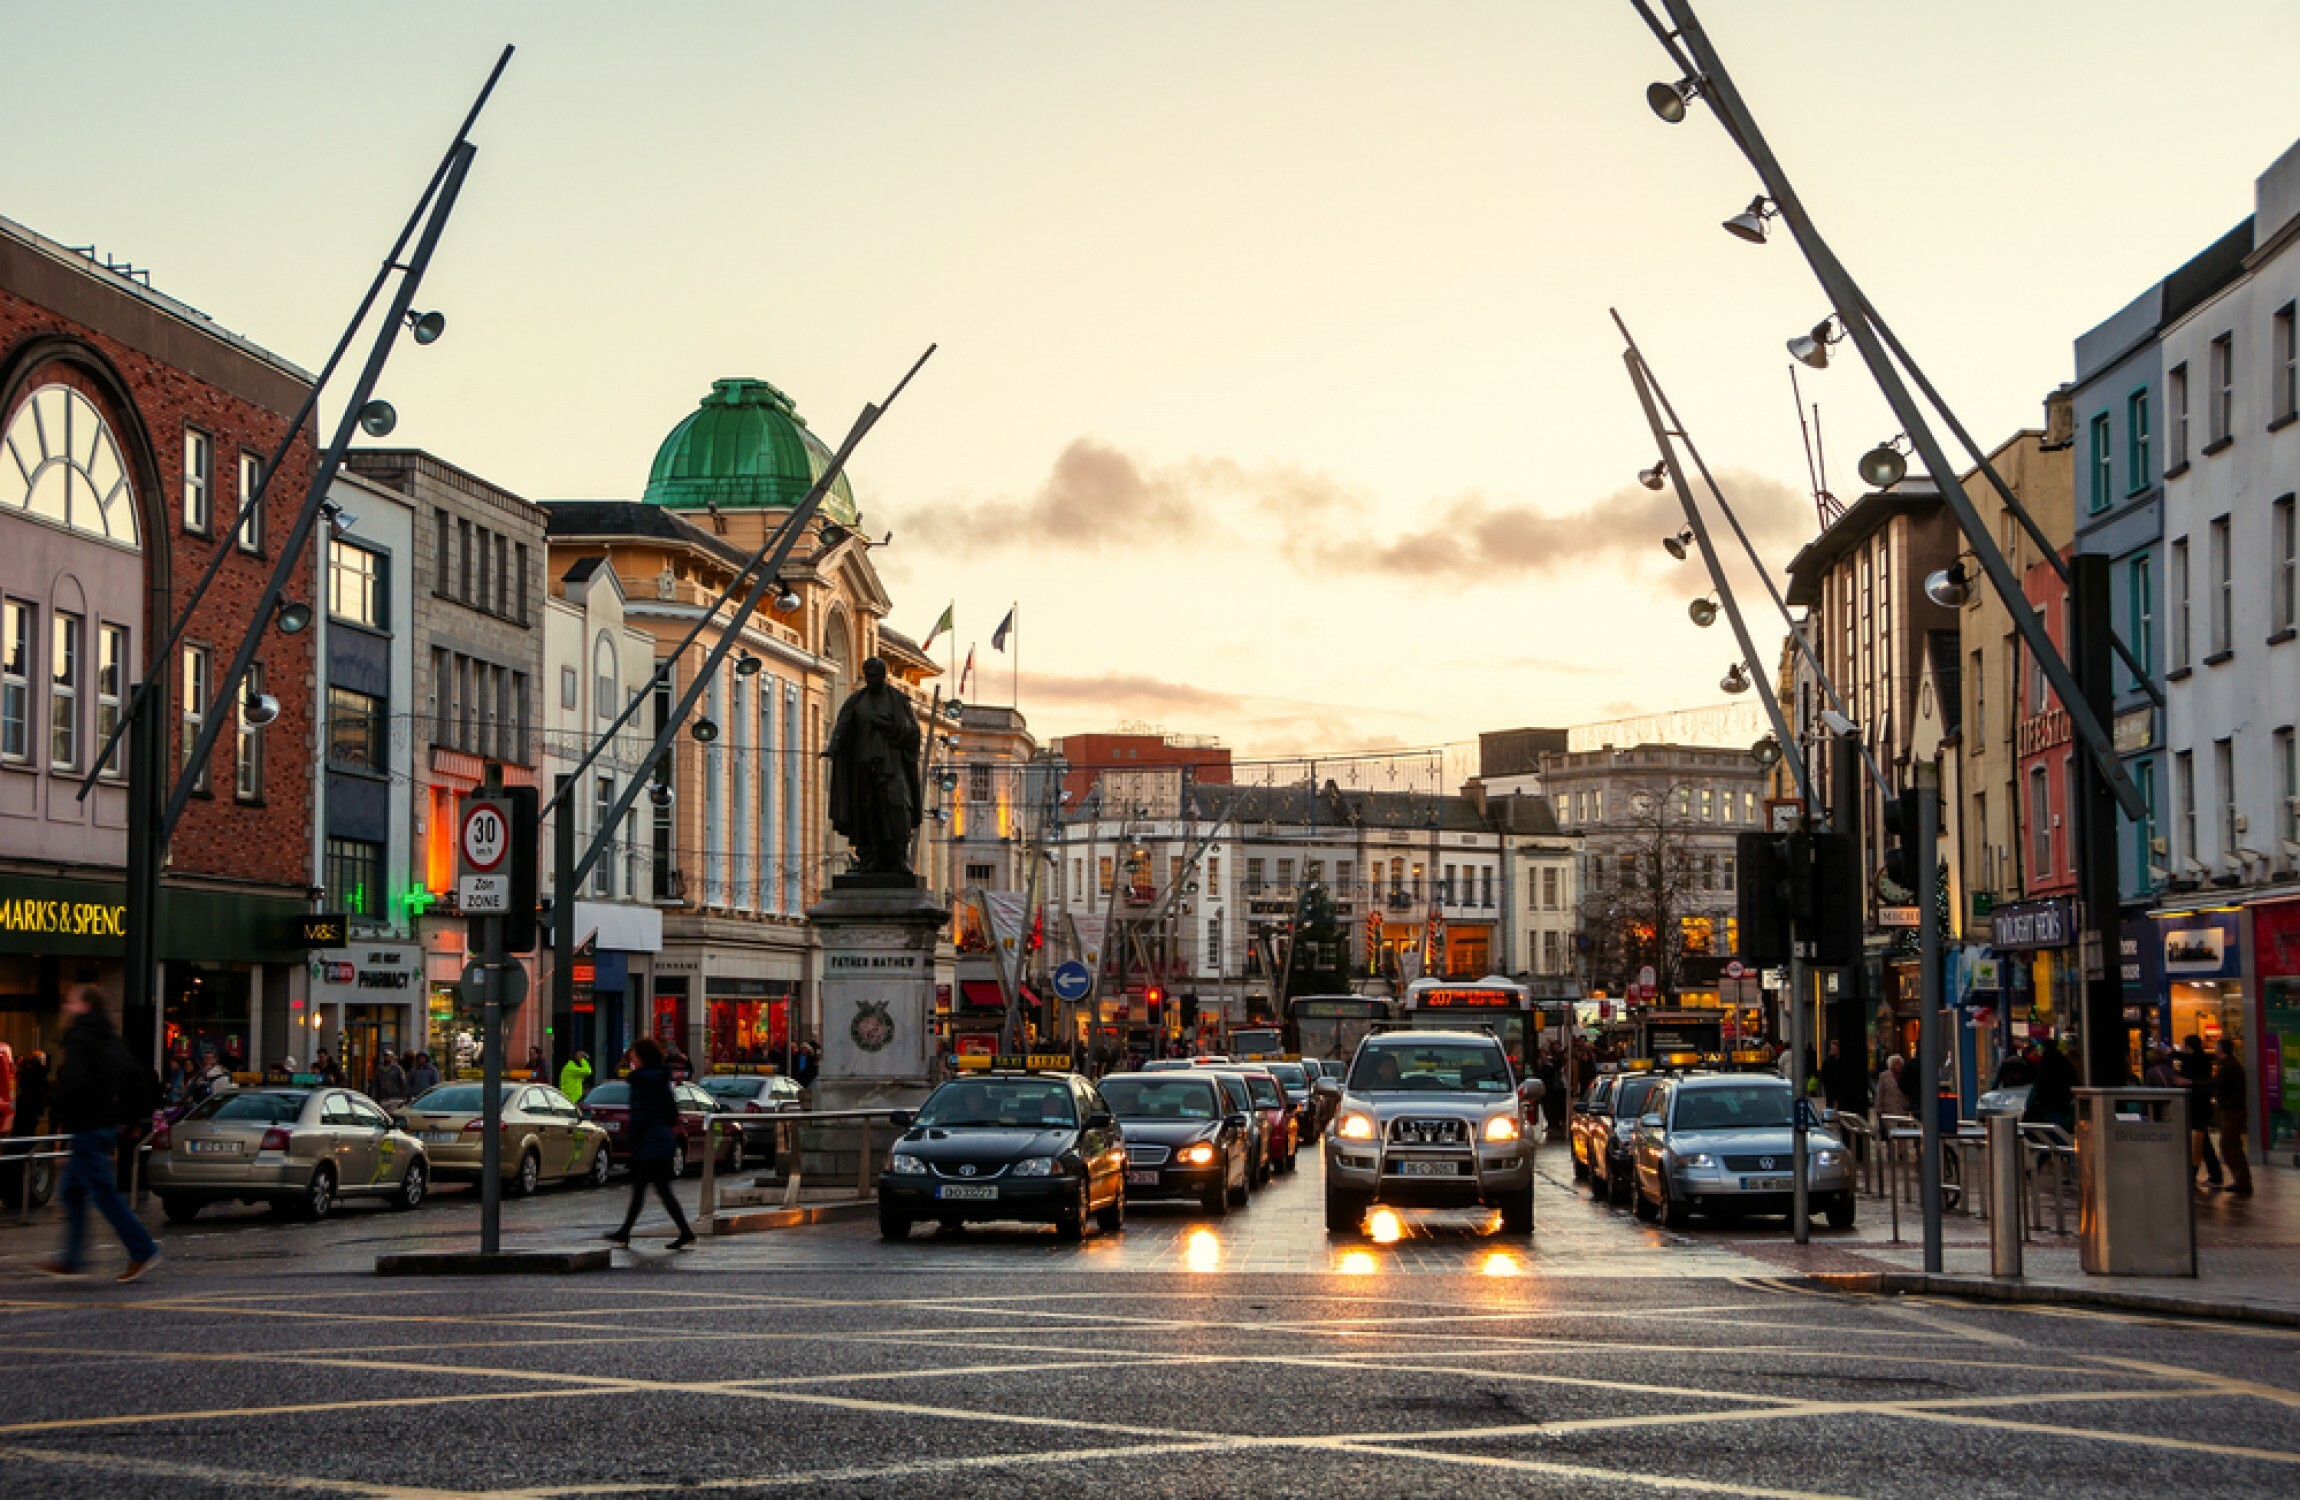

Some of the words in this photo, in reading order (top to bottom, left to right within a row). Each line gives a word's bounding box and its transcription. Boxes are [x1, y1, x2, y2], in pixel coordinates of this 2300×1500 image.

[474, 817, 495, 843] 30
[467, 895, 499, 907] ZONE
[303, 924, 342, 940] M&S
[832, 957, 868, 968] FATHER
[872, 957, 915, 968] MATHEW
[359, 972, 409, 988] PHARMACY
[1428, 990, 1452, 1007] 207
